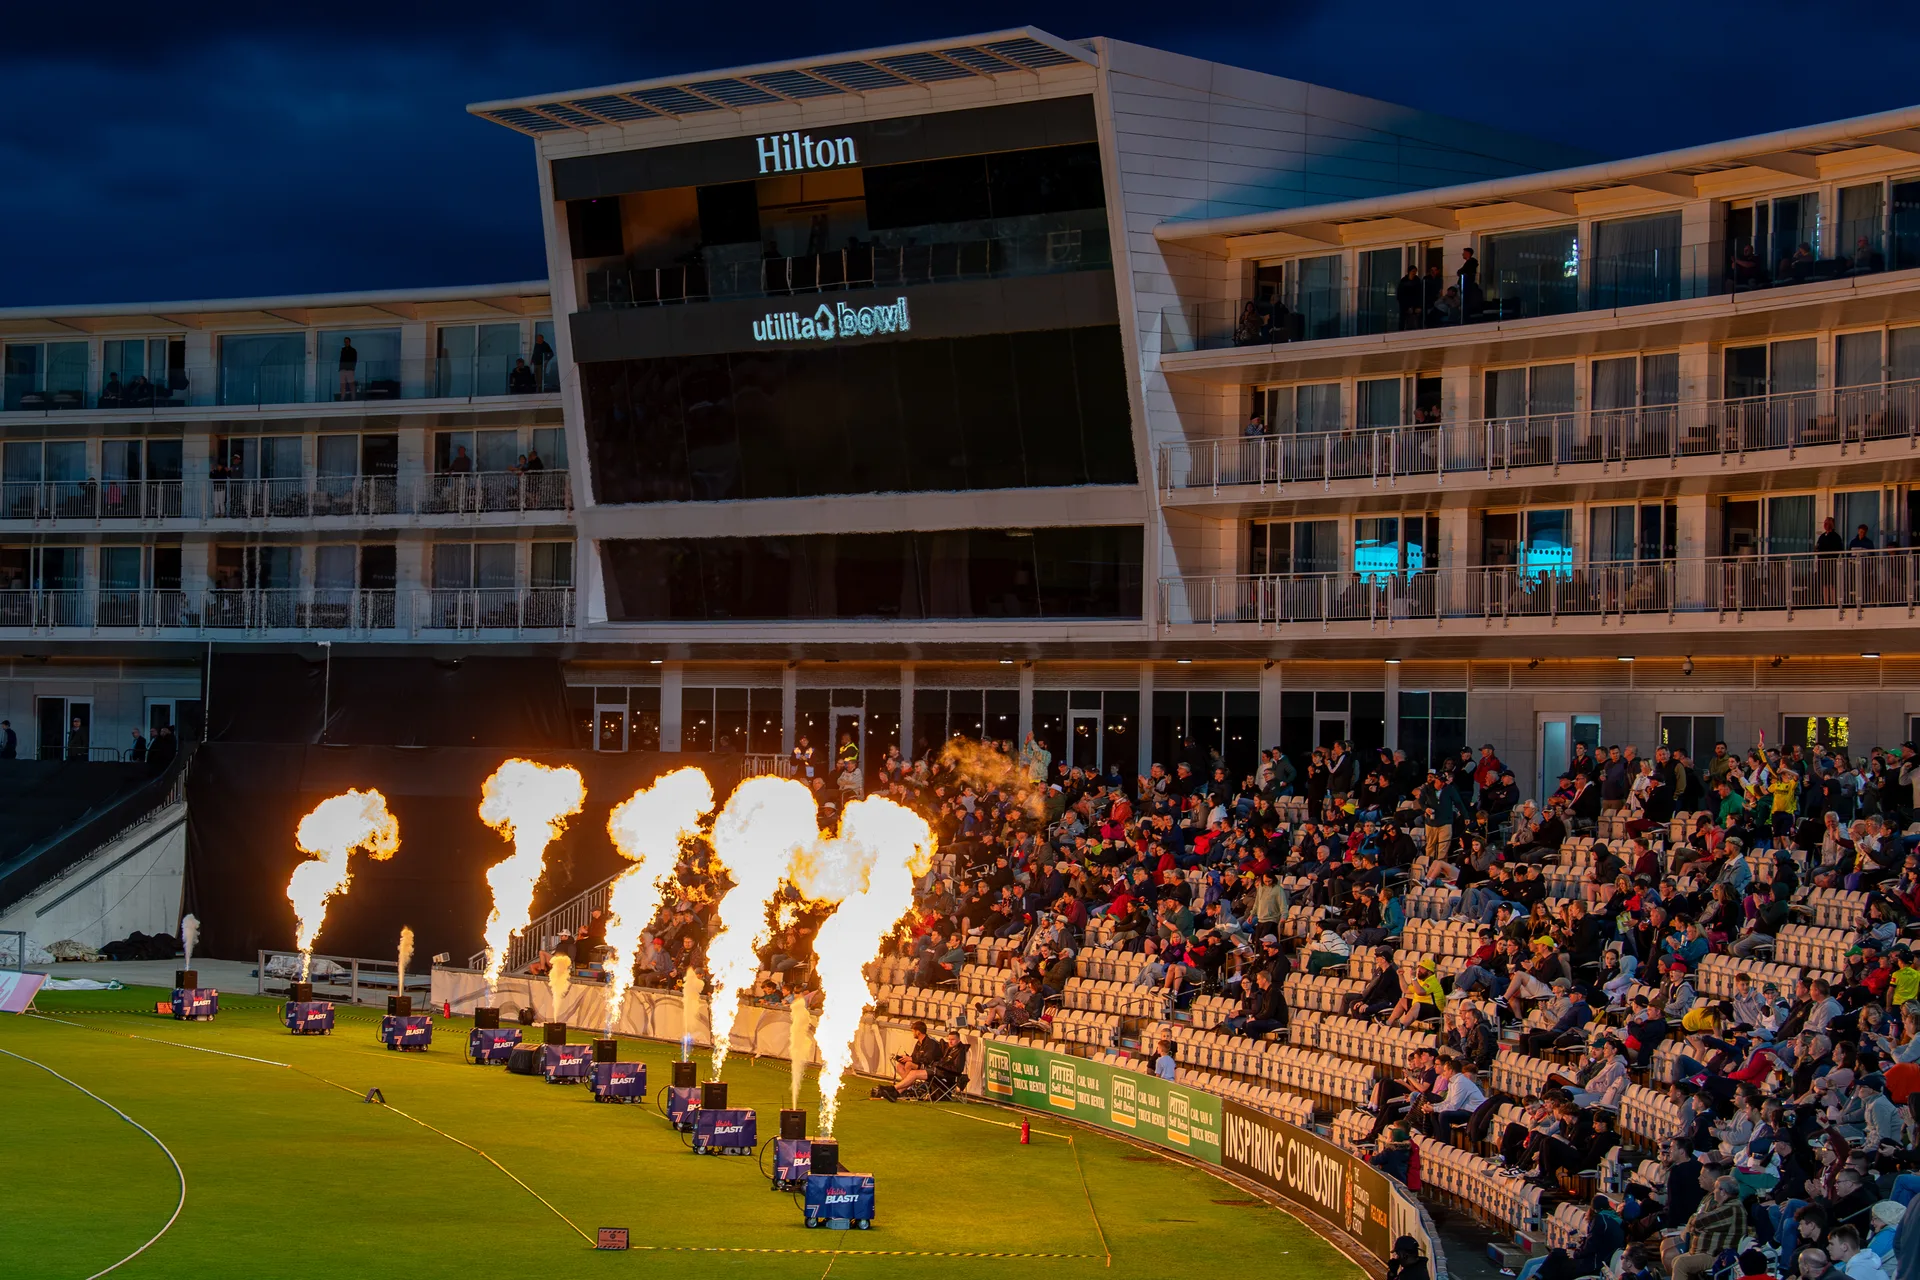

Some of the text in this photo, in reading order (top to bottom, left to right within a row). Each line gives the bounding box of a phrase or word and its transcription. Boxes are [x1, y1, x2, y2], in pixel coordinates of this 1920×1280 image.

[756, 131, 858, 174] Hilton
[753, 297, 910, 342] utilita bowl
[559, 1058, 583, 1066] BLAST!
[989, 1053, 1009, 1071] PITTER
[1024, 1064, 1033, 1076] VAN
[1035, 1066, 1039, 1076] &
[610, 1077, 635, 1085] BLAST!
[989, 1069, 997, 1079] Self
[1051, 1065, 1074, 1084] PITTER
[1013, 1078, 1047, 1094] TRUCK RENTAL
[1051, 1082, 1074, 1096] Self Drive
[1087, 1077, 1096, 1090] VAN
[1095, 1080, 1099, 1091] &
[1114, 1081, 1134, 1101] PITTER
[1077, 1091, 1105, 1109] TRUCK RENTAL
[1114, 1098, 1135, 1114] Self Drive
[1148, 1094, 1156, 1107] VAN
[1156, 1097, 1160, 1108] &
[1169, 1096, 1188, 1118] PITTER
[1138, 1108, 1166, 1128] TRUCK RENTAL
[1169, 1115, 1188, 1131] Self Drive
[1200, 1111, 1208, 1124] VAN
[1209, 1114, 1212, 1126] &
[714, 1125, 743, 1134] BLAST!
[1190, 1126, 1219, 1146] TRUCK RENTAL
[793, 1157, 811, 1167] BLA
[1225, 1112, 1343, 1213] INSPIRING CURIOSITY
[825, 1194, 859, 1204] BLAST!
